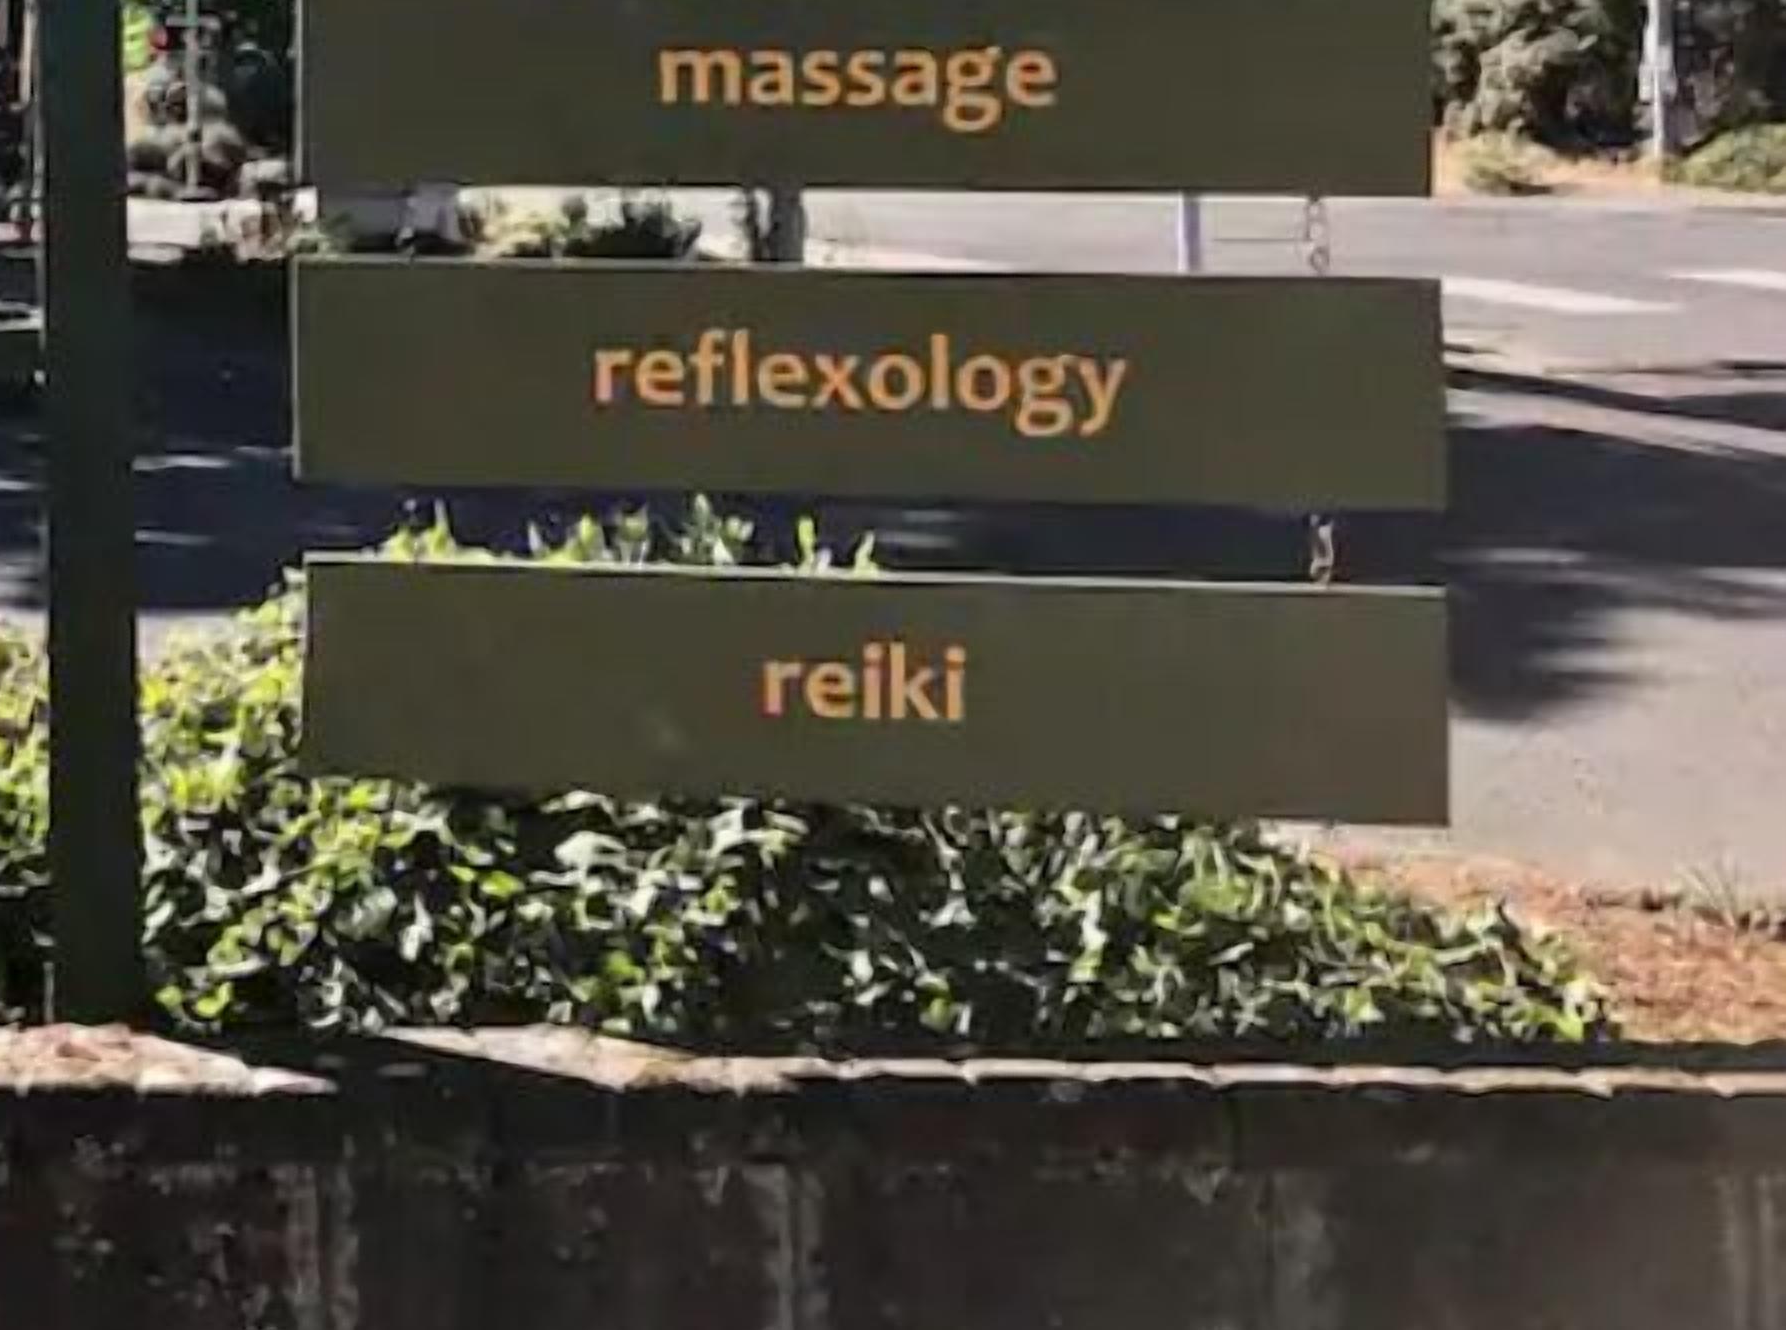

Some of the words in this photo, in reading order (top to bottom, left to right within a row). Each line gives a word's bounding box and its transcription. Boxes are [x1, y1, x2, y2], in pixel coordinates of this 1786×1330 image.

[657, 43, 1059, 132] massage
[591, 327, 1128, 436] reflexology
[761, 642, 968, 721] reiki
